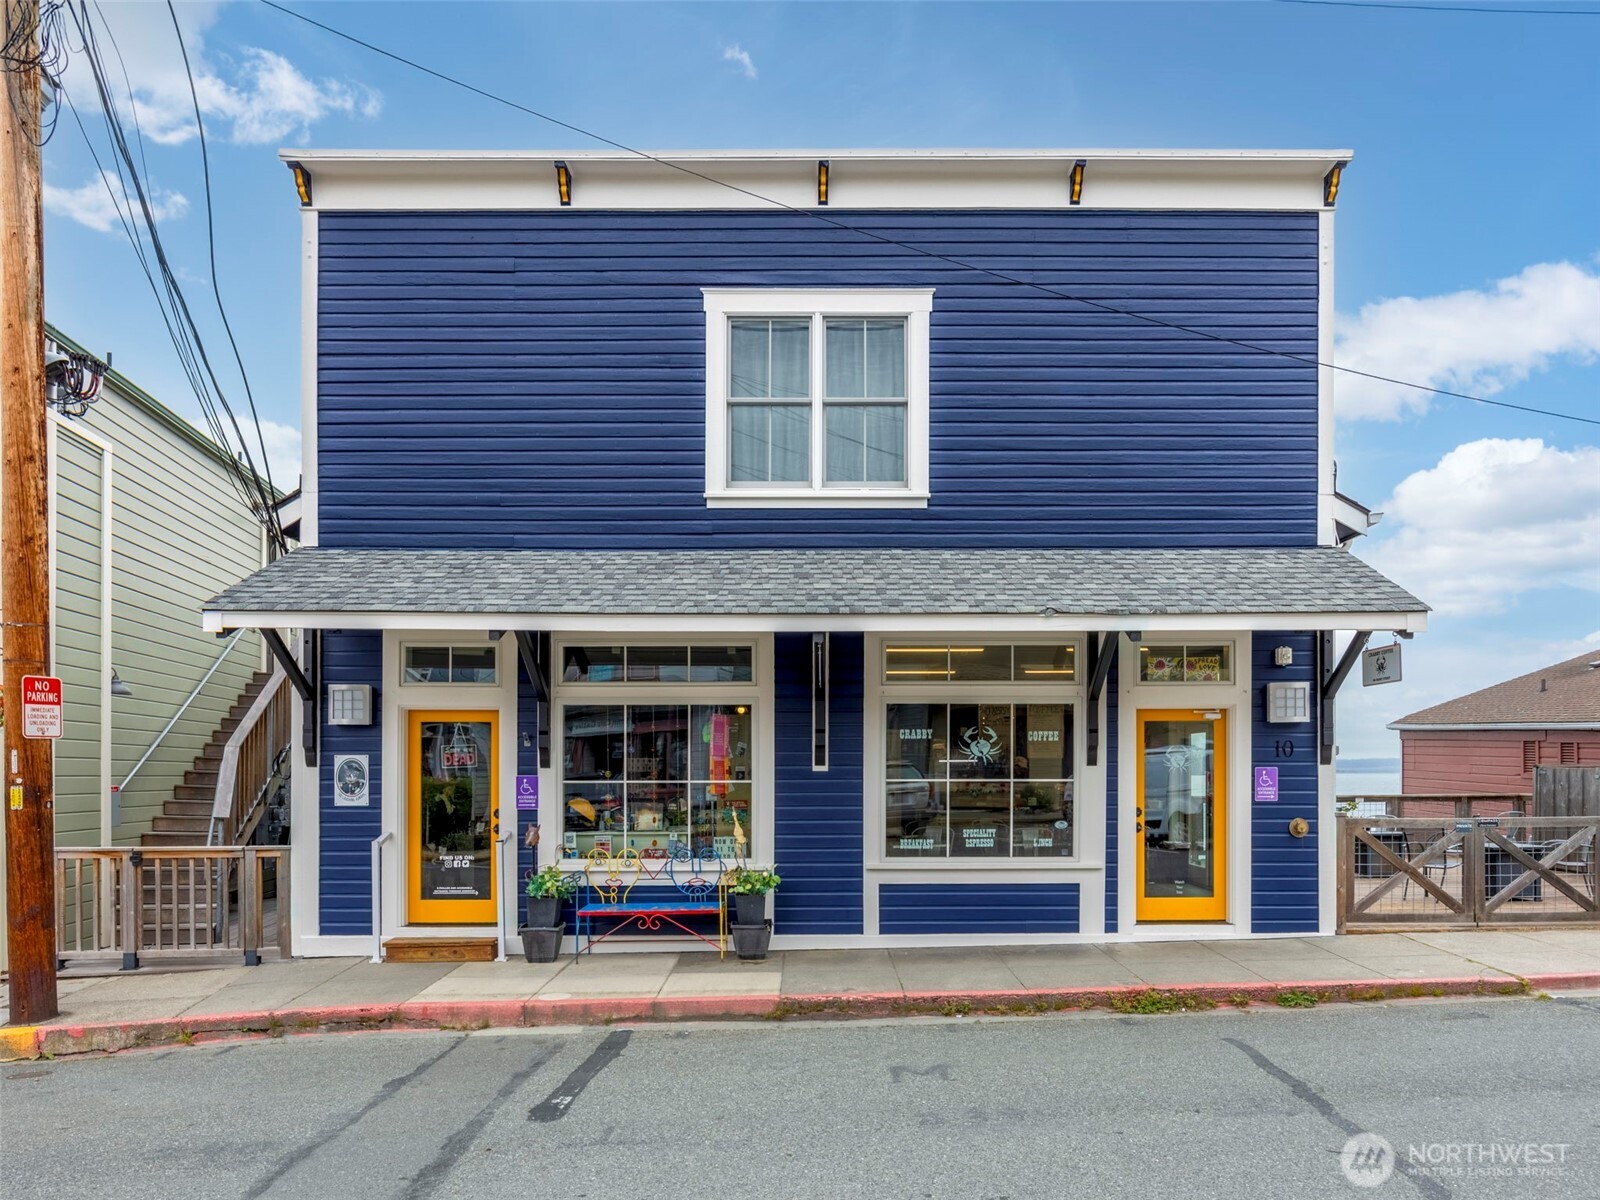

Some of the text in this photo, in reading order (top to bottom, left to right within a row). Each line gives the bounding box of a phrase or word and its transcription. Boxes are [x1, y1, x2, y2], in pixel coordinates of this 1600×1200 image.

[1194, 657, 1218, 665] SPREAD
[34, 681, 50, 691] NO
[27, 691, 58, 702] PARKING
[900, 728, 933, 739] CRABBY
[1027, 730, 1059, 742] COFFEE
[1275, 739, 1294, 758] 10
[444, 753, 475, 766] DEAD
[900, 839, 934, 849] BREAKFAST
[965, 839, 994, 848] ESPRESSO
